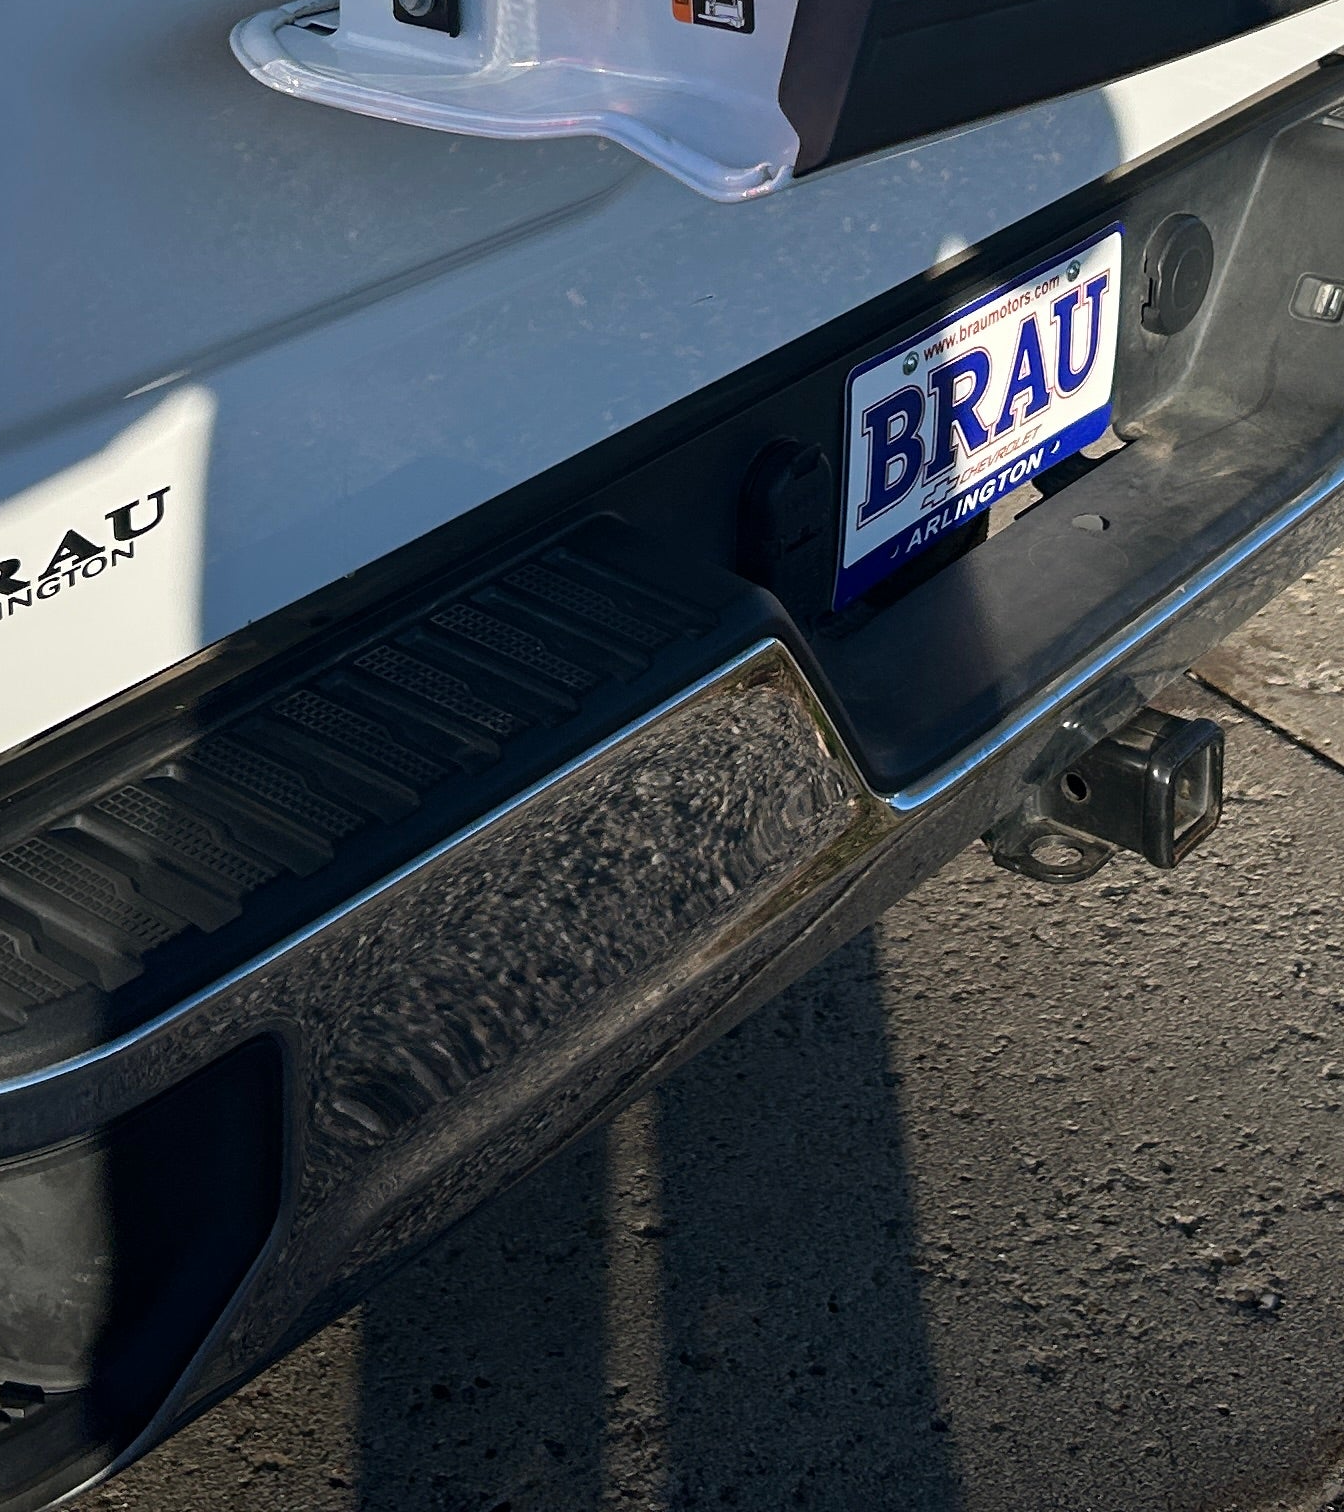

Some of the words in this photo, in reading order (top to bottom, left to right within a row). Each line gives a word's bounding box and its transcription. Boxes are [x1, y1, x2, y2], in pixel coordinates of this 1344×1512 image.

[922, 275, 1061, 361] www.braumotors.com
[856, 268, 1111, 530] BRAU
[905, 447, 1045, 553] ARLINGTON
[960, 424, 1042, 484] CHEVROLET
